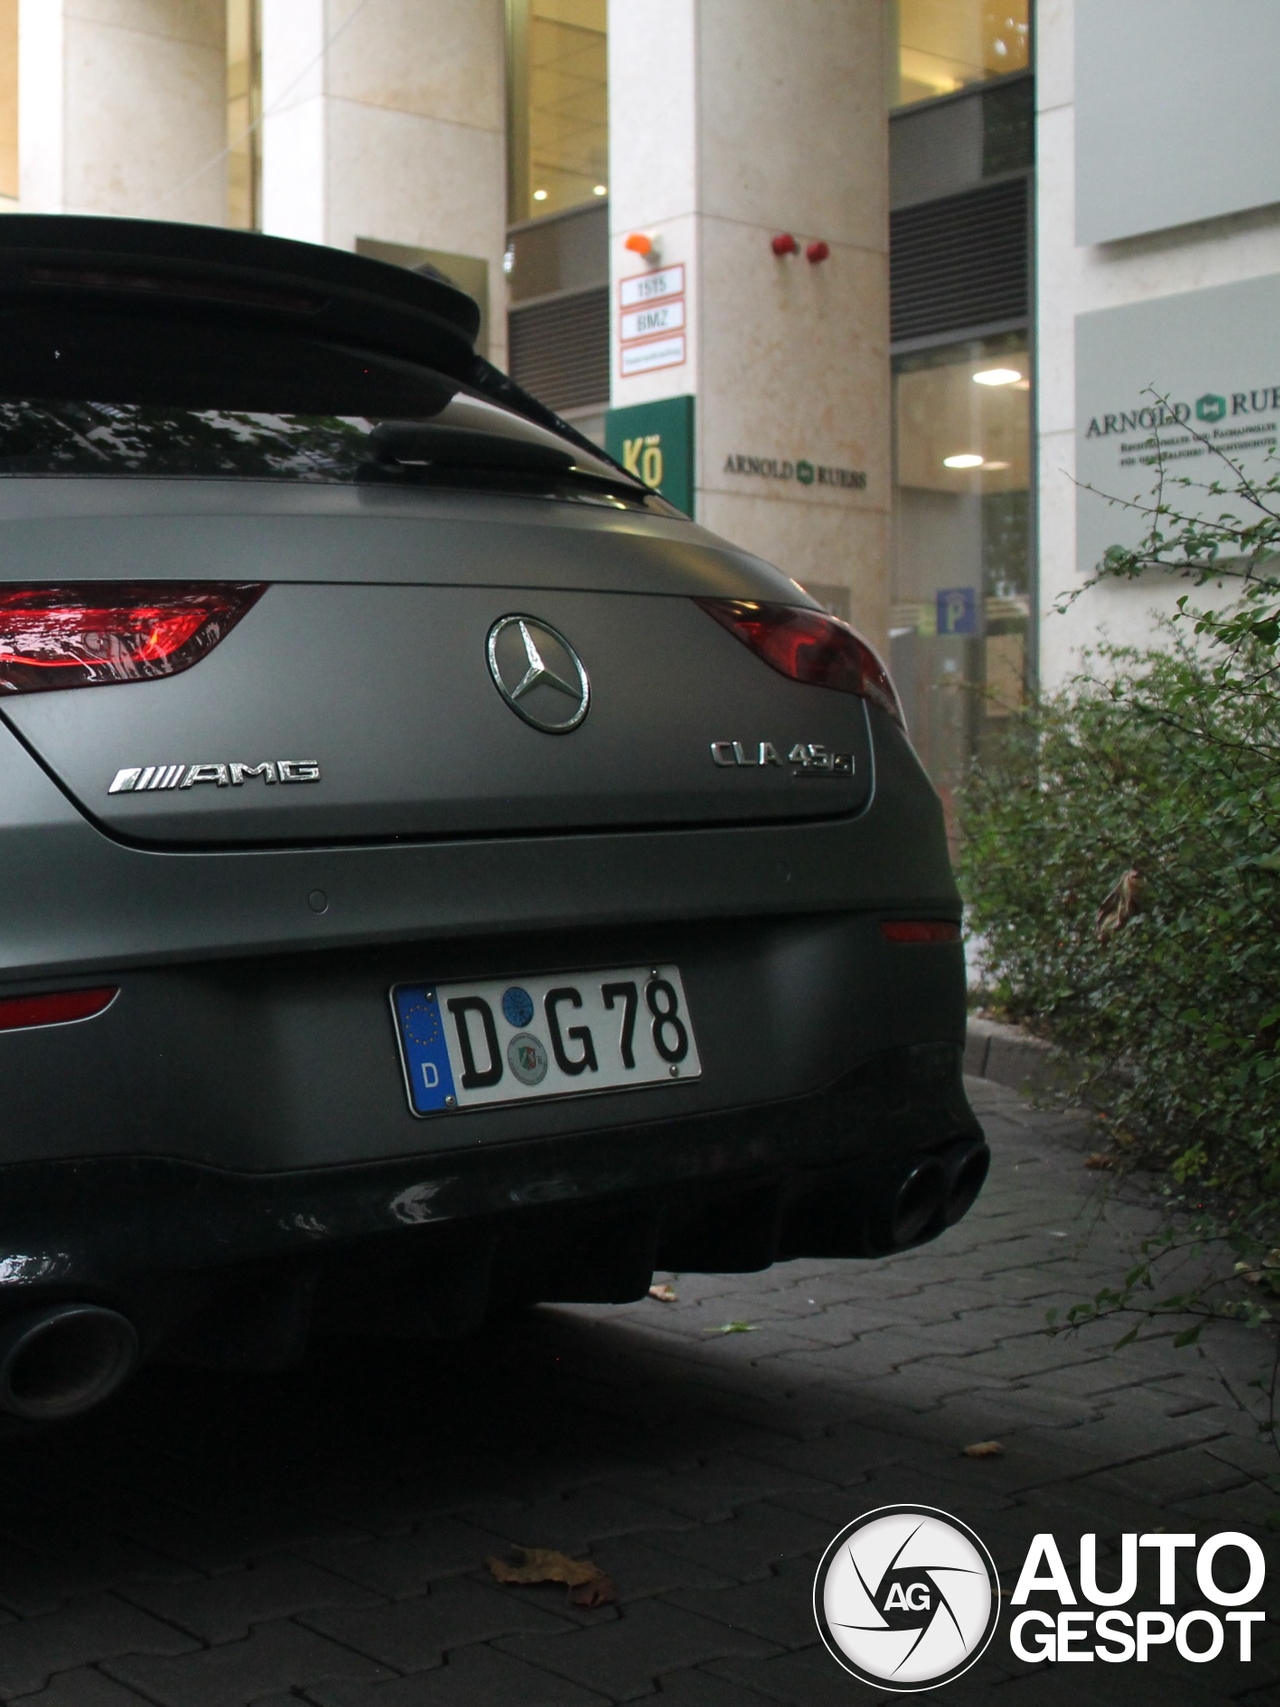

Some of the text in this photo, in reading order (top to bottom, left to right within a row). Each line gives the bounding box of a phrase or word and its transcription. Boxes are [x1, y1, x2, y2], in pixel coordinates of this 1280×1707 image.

[637, 309, 669, 333] BMZ
[1086, 402, 1192, 438] ARNOLD
[724, 454, 794, 481] ARNOLD
[711, 741, 783, 767] CLA
[179, 760, 321, 790] AMG
[447, 995, 504, 1090] D
[422, 1062, 439, 1088] D
